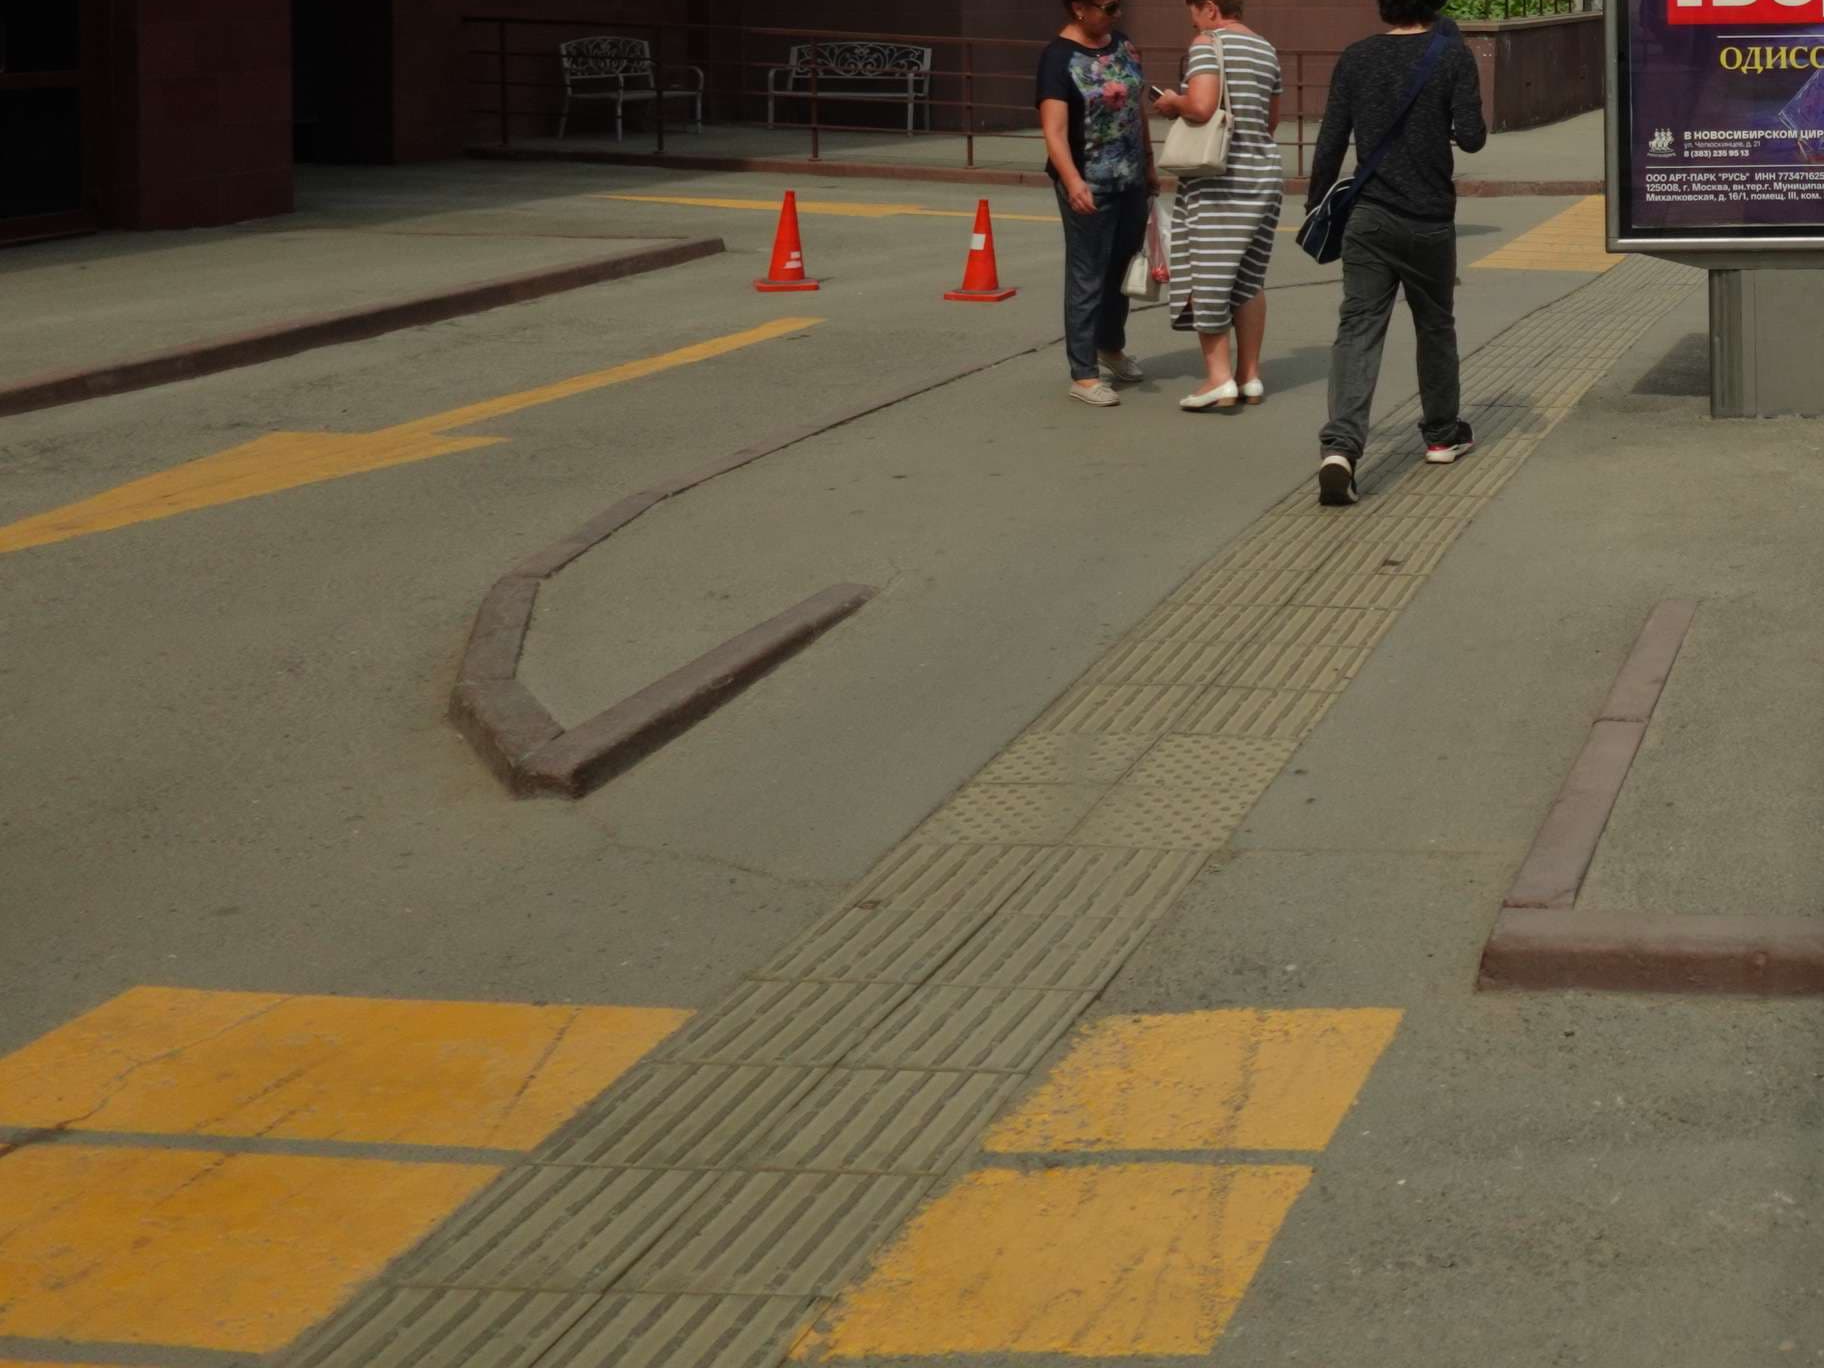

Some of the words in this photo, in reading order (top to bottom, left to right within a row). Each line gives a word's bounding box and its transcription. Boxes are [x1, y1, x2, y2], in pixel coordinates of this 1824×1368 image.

[1683, 131, 1692, 140] В
[1694, 130, 1798, 140] НОВОСИБИРСКОМ
[1690, 150, 1712, 159] (383)
[1646, 173, 1667, 182] ООО
[1669, 173, 1717, 182] АРТ-ПАРК
[1718, 173, 1750, 181] "РУСЬ"
[1755, 172, 1776, 181] ИНН
[1692, 183, 1730, 192] Москва,
[1800, 192, 1820, 200] ком.
